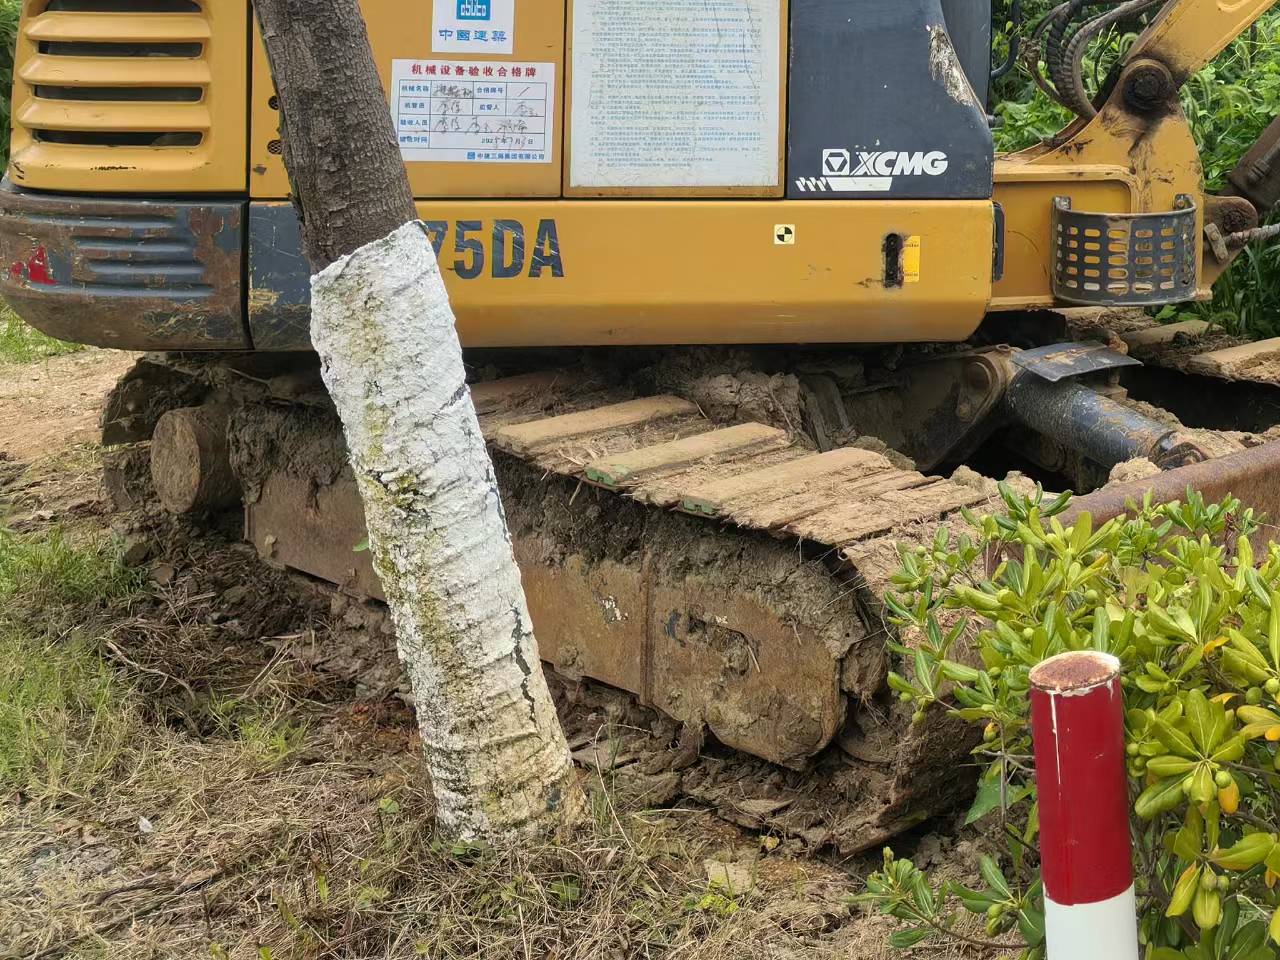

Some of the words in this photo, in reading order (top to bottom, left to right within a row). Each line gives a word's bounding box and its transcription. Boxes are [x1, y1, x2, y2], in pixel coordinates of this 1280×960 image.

[410, 64, 536, 77] 机械设备验收合格牌
[850, 150, 949, 176] XCMG
